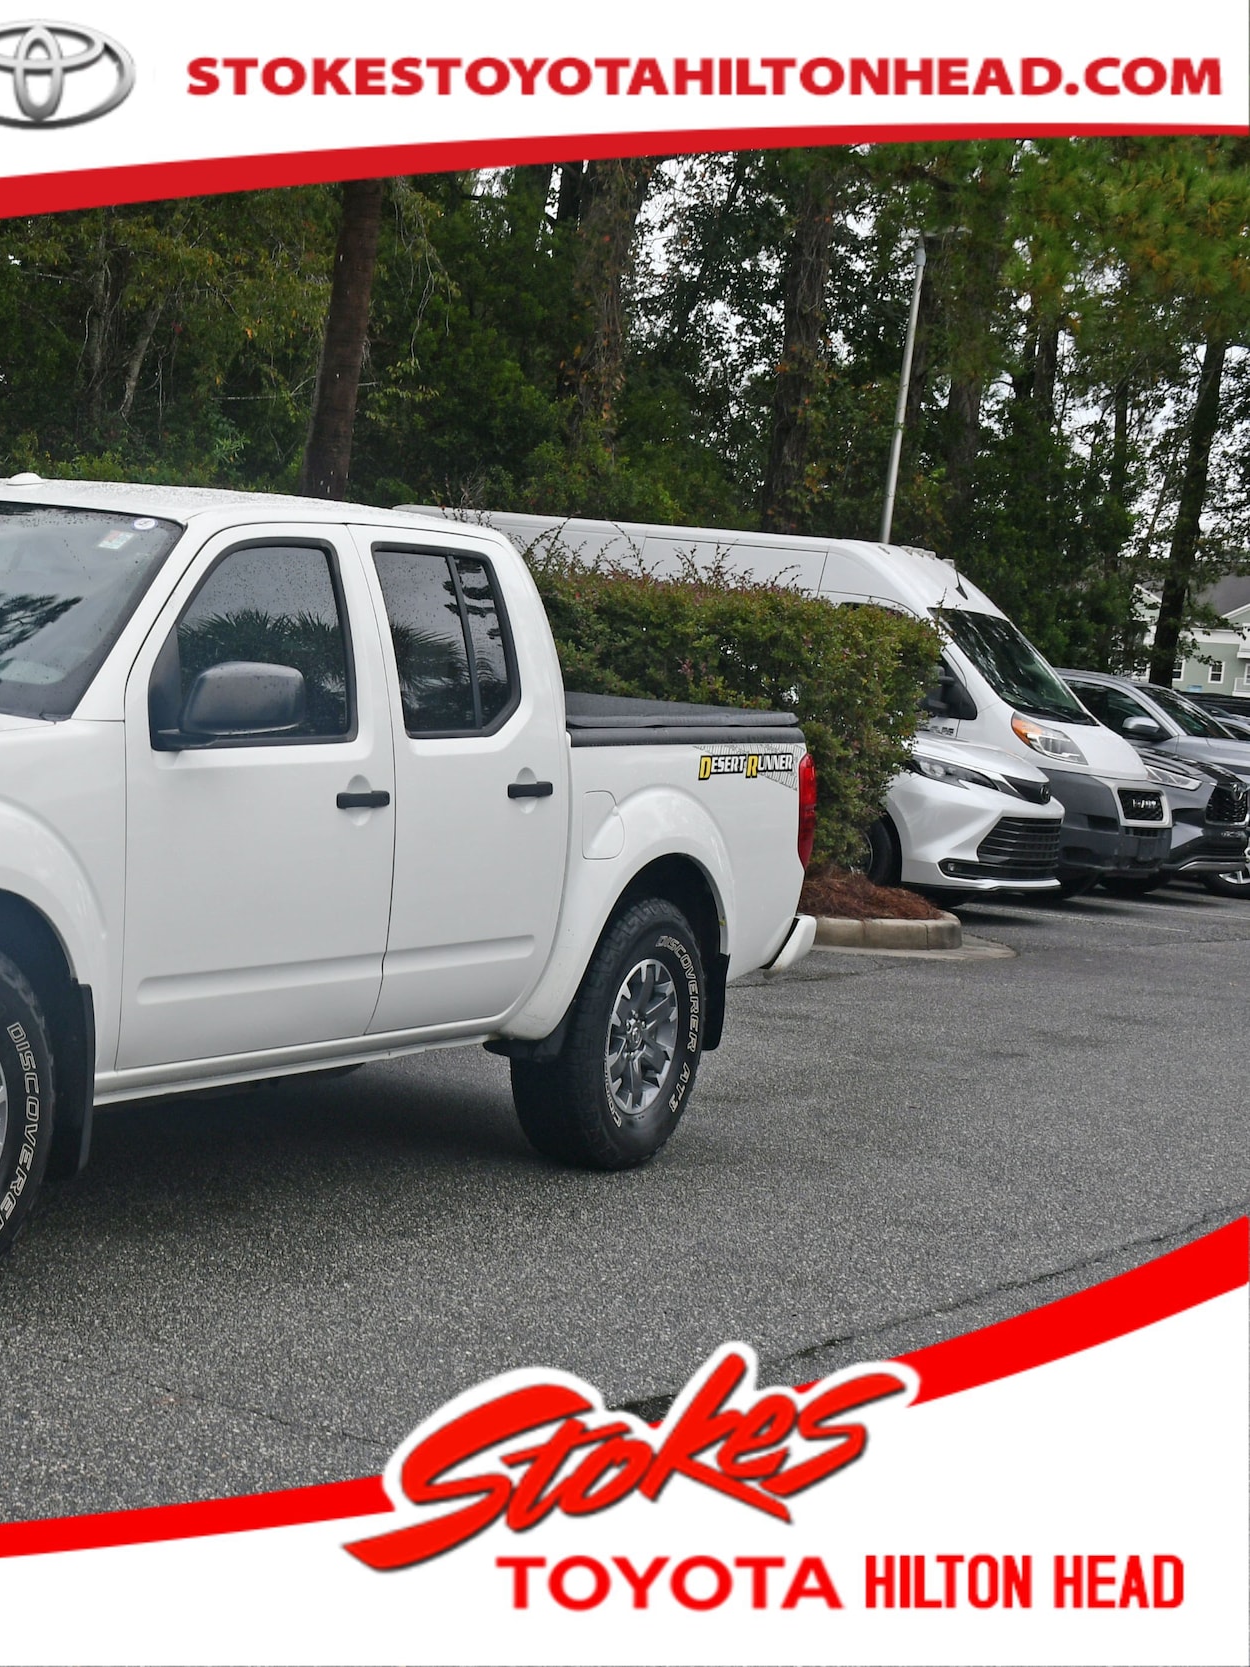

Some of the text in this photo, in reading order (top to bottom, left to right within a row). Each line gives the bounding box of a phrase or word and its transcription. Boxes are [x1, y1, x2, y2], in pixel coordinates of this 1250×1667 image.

[698, 753, 793, 780] DESERT RUNNER
[655, 935, 700, 1053] DISCOVERER
